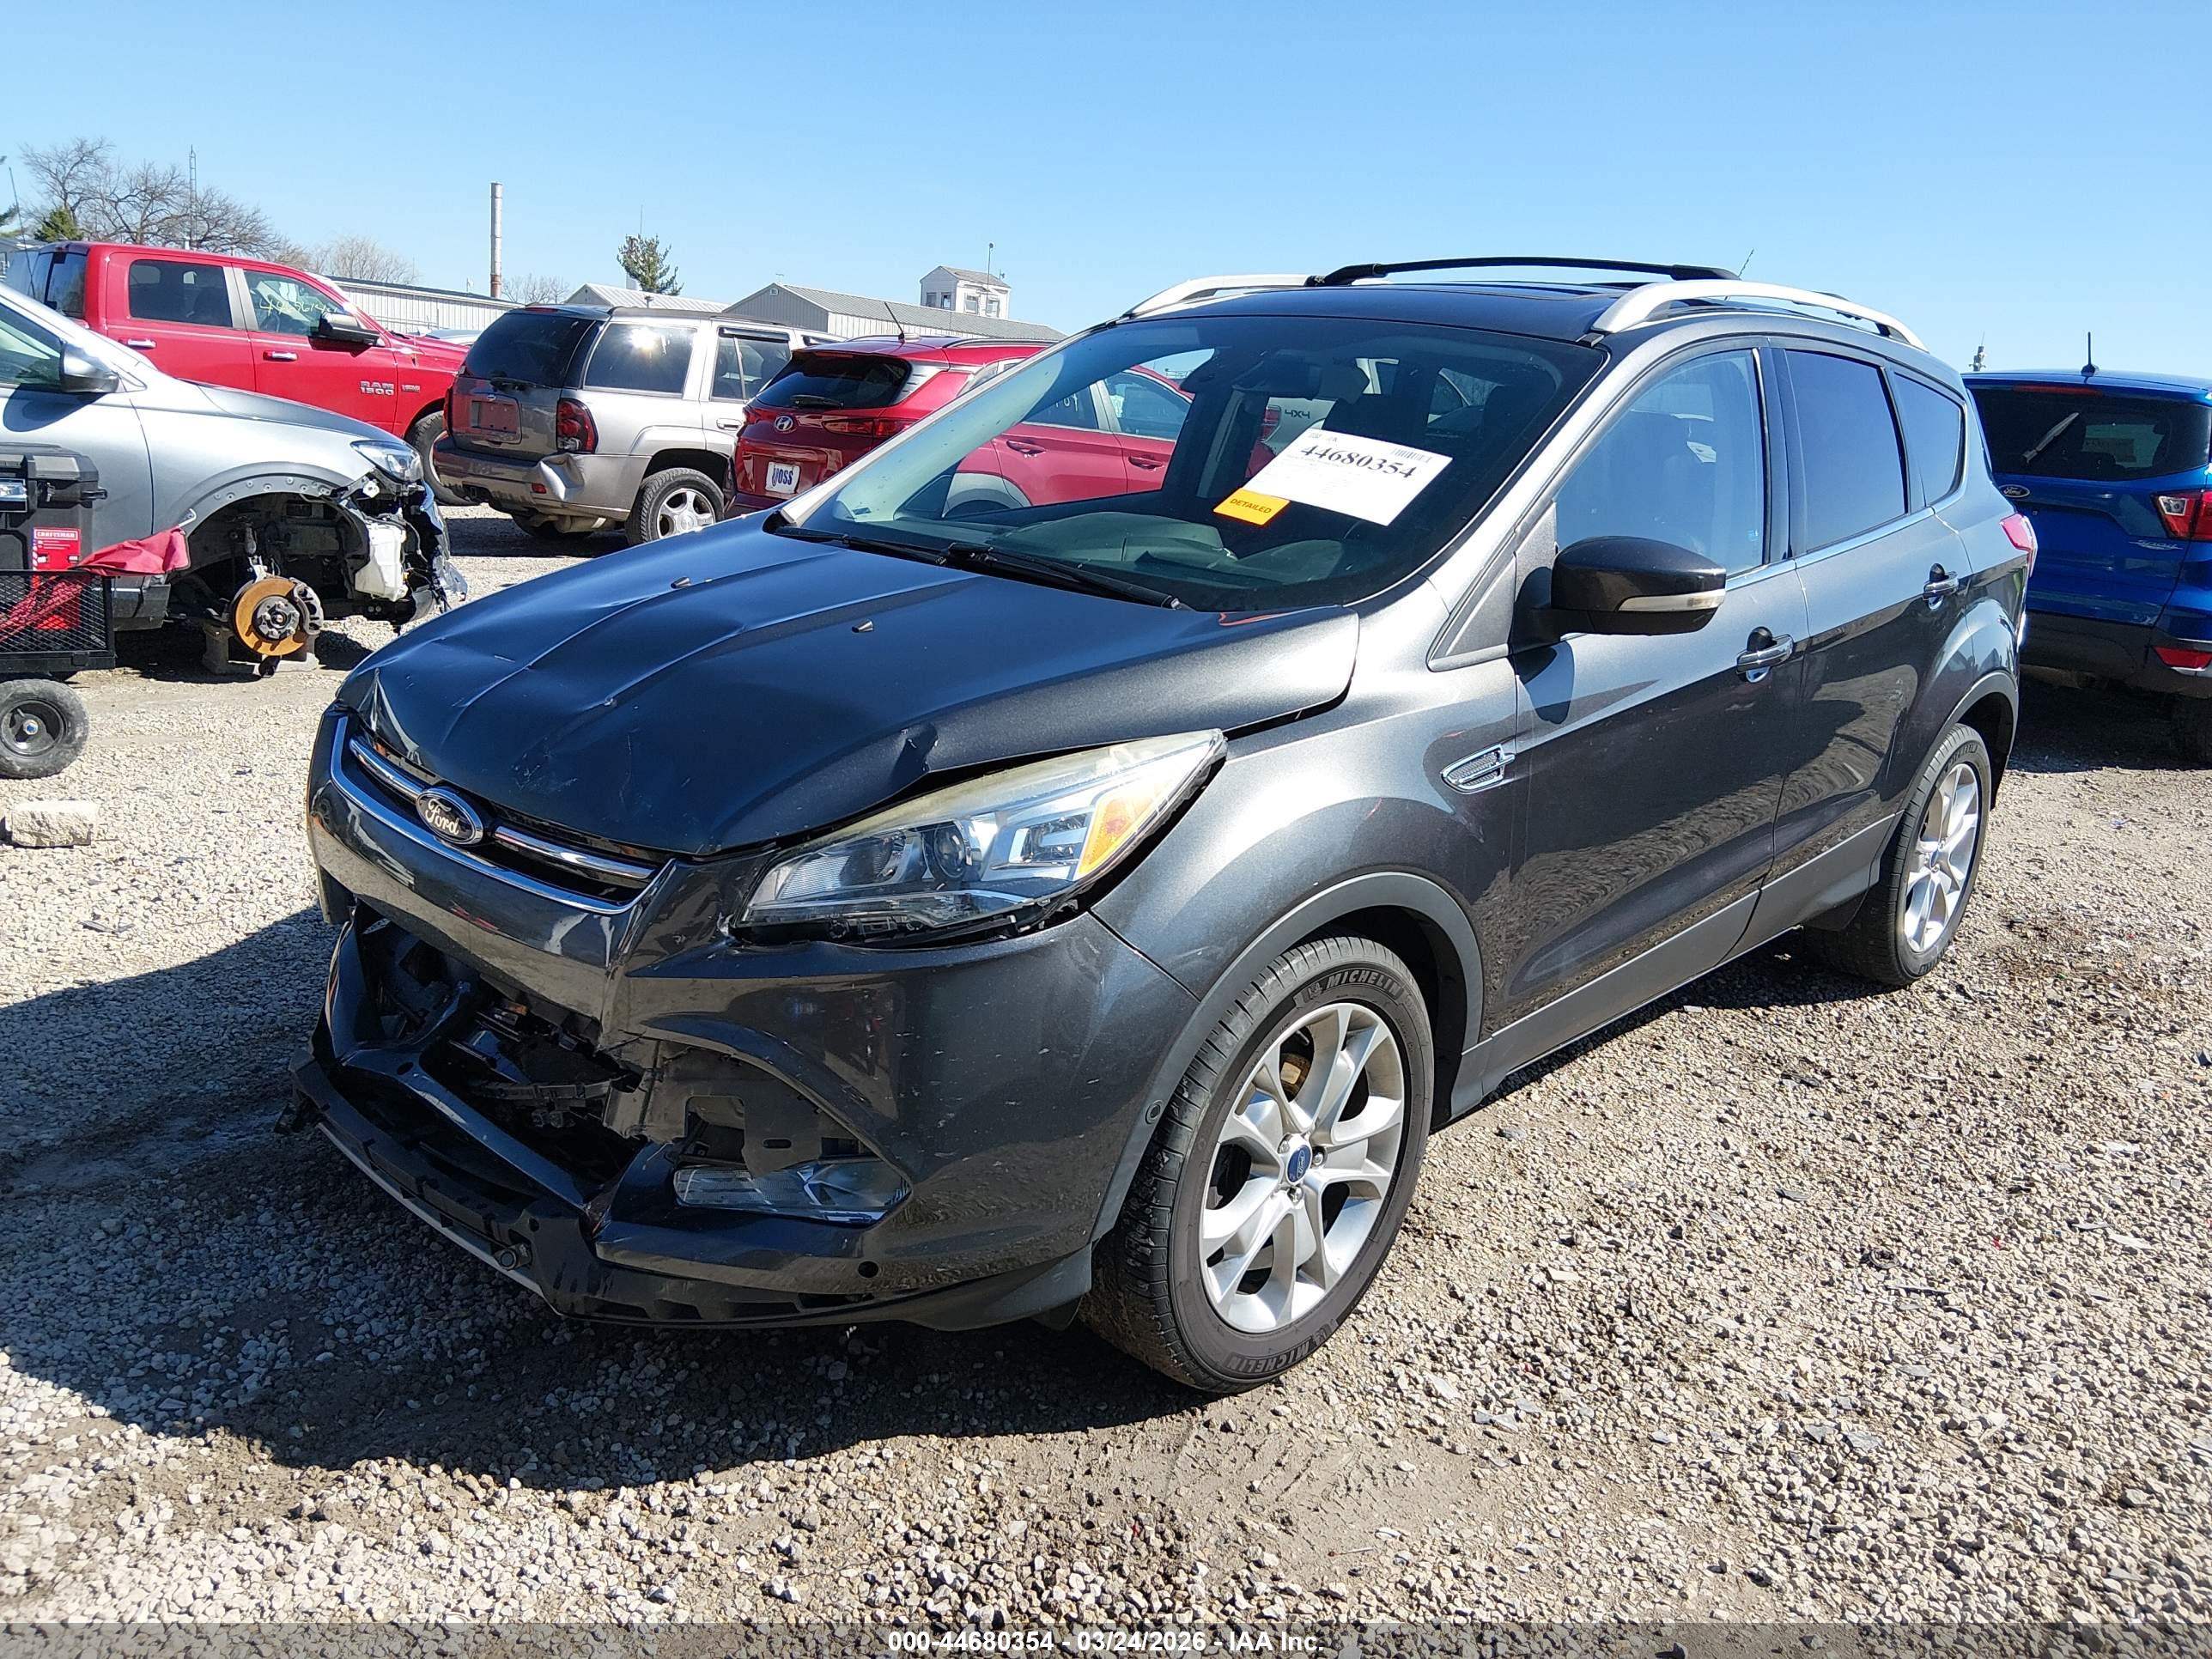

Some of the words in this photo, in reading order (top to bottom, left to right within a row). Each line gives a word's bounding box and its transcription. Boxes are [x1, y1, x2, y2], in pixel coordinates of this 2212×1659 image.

[360, 380, 394, 389] RAM
[360, 387, 394, 396] 1500
[1301, 444, 1417, 478] 44680354
[1229, 497, 1272, 514] DETAILED
[424, 798, 461, 836] Ford
[1326, 969, 1401, 1000] MICHELIN
[1227, 1340, 1310, 1374] MICHELIN
